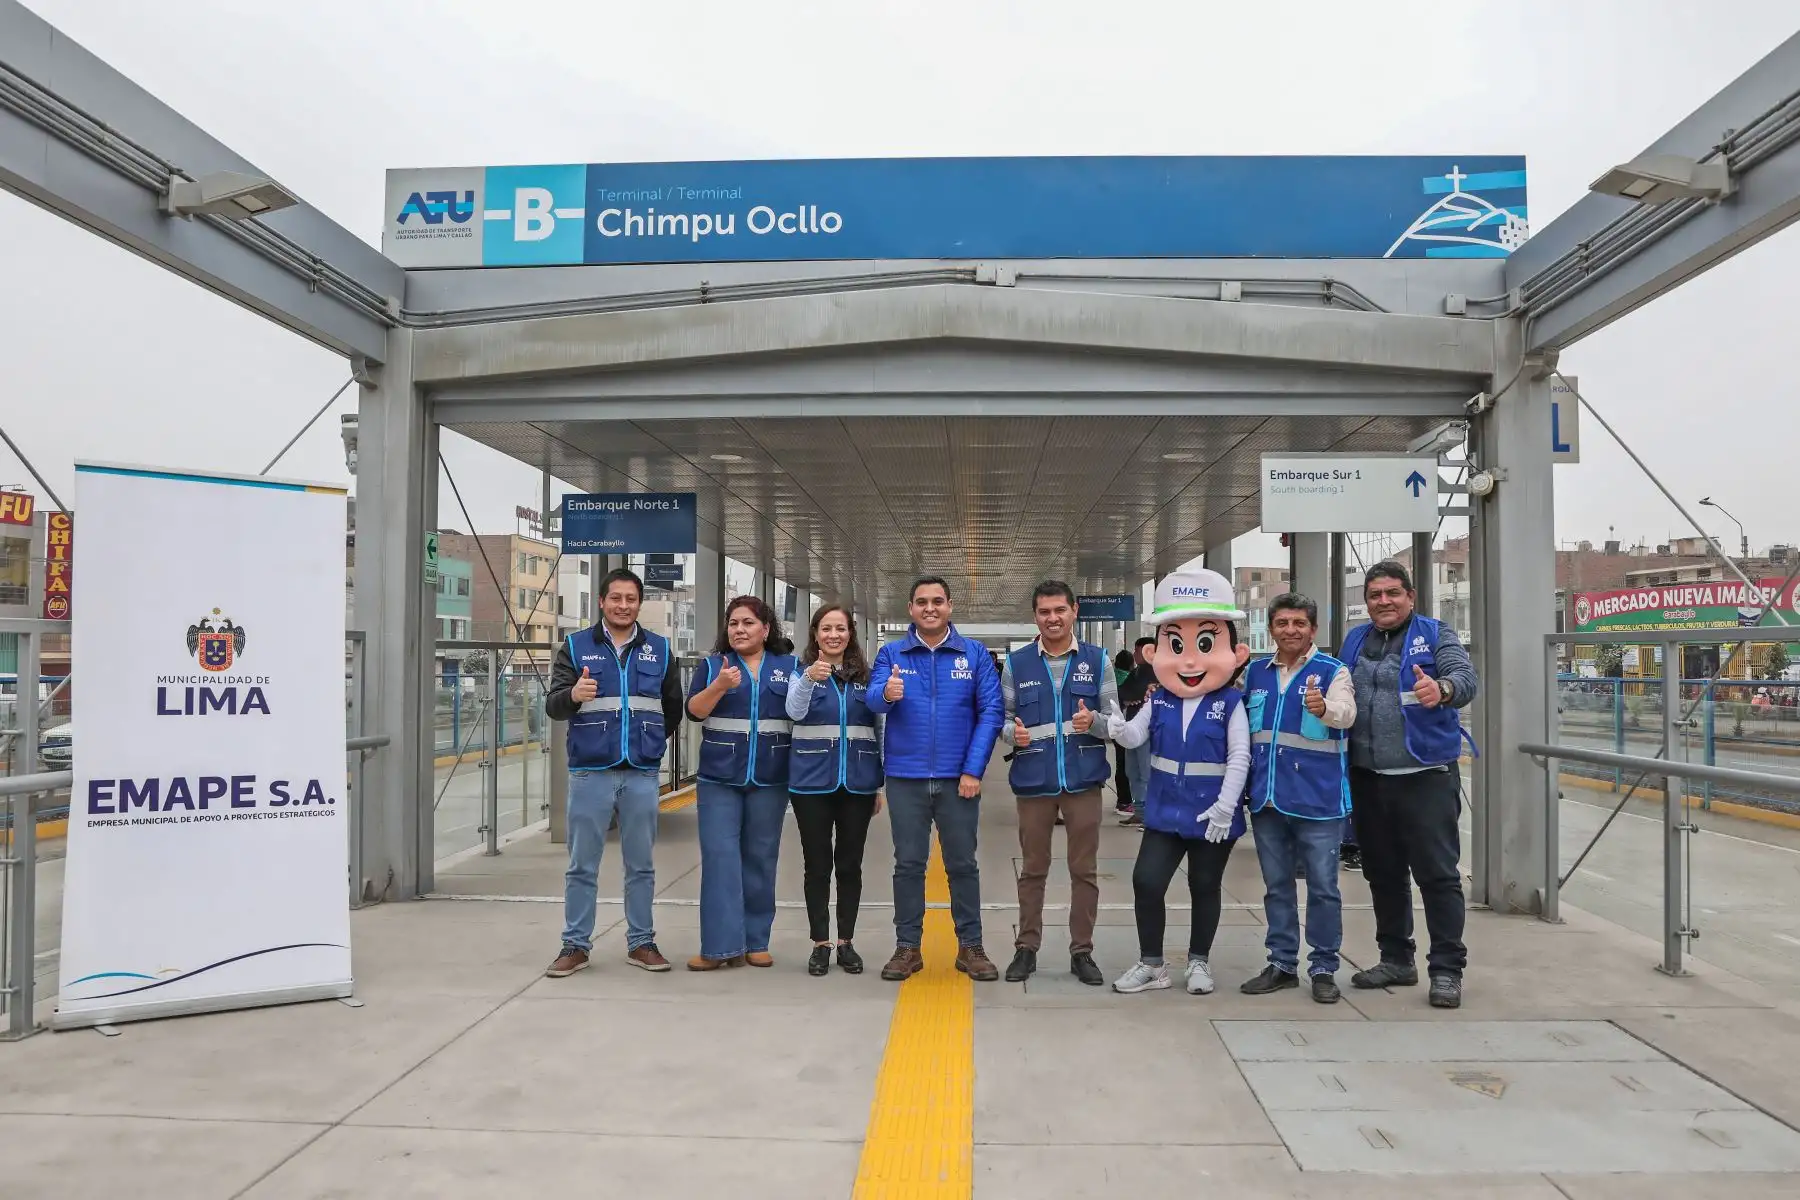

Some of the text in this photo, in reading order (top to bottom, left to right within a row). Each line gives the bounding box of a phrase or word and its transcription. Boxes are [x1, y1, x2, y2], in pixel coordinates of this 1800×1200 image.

[597, 187, 662, 202] Terminal
[677, 186, 743, 201] Terminal
[513, 187, 555, 242] B
[597, 205, 843, 243] Chimpu Ocllo
[1270, 469, 1362, 482] Embarque Sur 1
[1270, 484, 1345, 495] South boarding 1
[567, 499, 680, 512] Embarque Norte 1
[588, 539, 625, 548] Carabayllo
[48, 514, 70, 592] CHIFA
[1172, 587, 1209, 597] EMAPE
[1594, 590, 1660, 618] MERCADO
[1663, 586, 1714, 607] NUEVA
[1687, 621, 1705, 629] FRUTAS
[1710, 620, 1738, 628] VERDURAS
[1409, 647, 1431, 656] LIMA
[157, 675, 270, 684] MUNICIPALIDAD DE
[951, 672, 973, 680] LIMA
[157, 686, 271, 715] LIMA
[87, 775, 336, 815] EMAPE S.A.
[87, 818, 130, 828] EMPRESA
[131, 816, 179, 826] MUNICIPAL
[193, 814, 222, 823] APOYO
[231, 812, 278, 821] PROYECTOS
